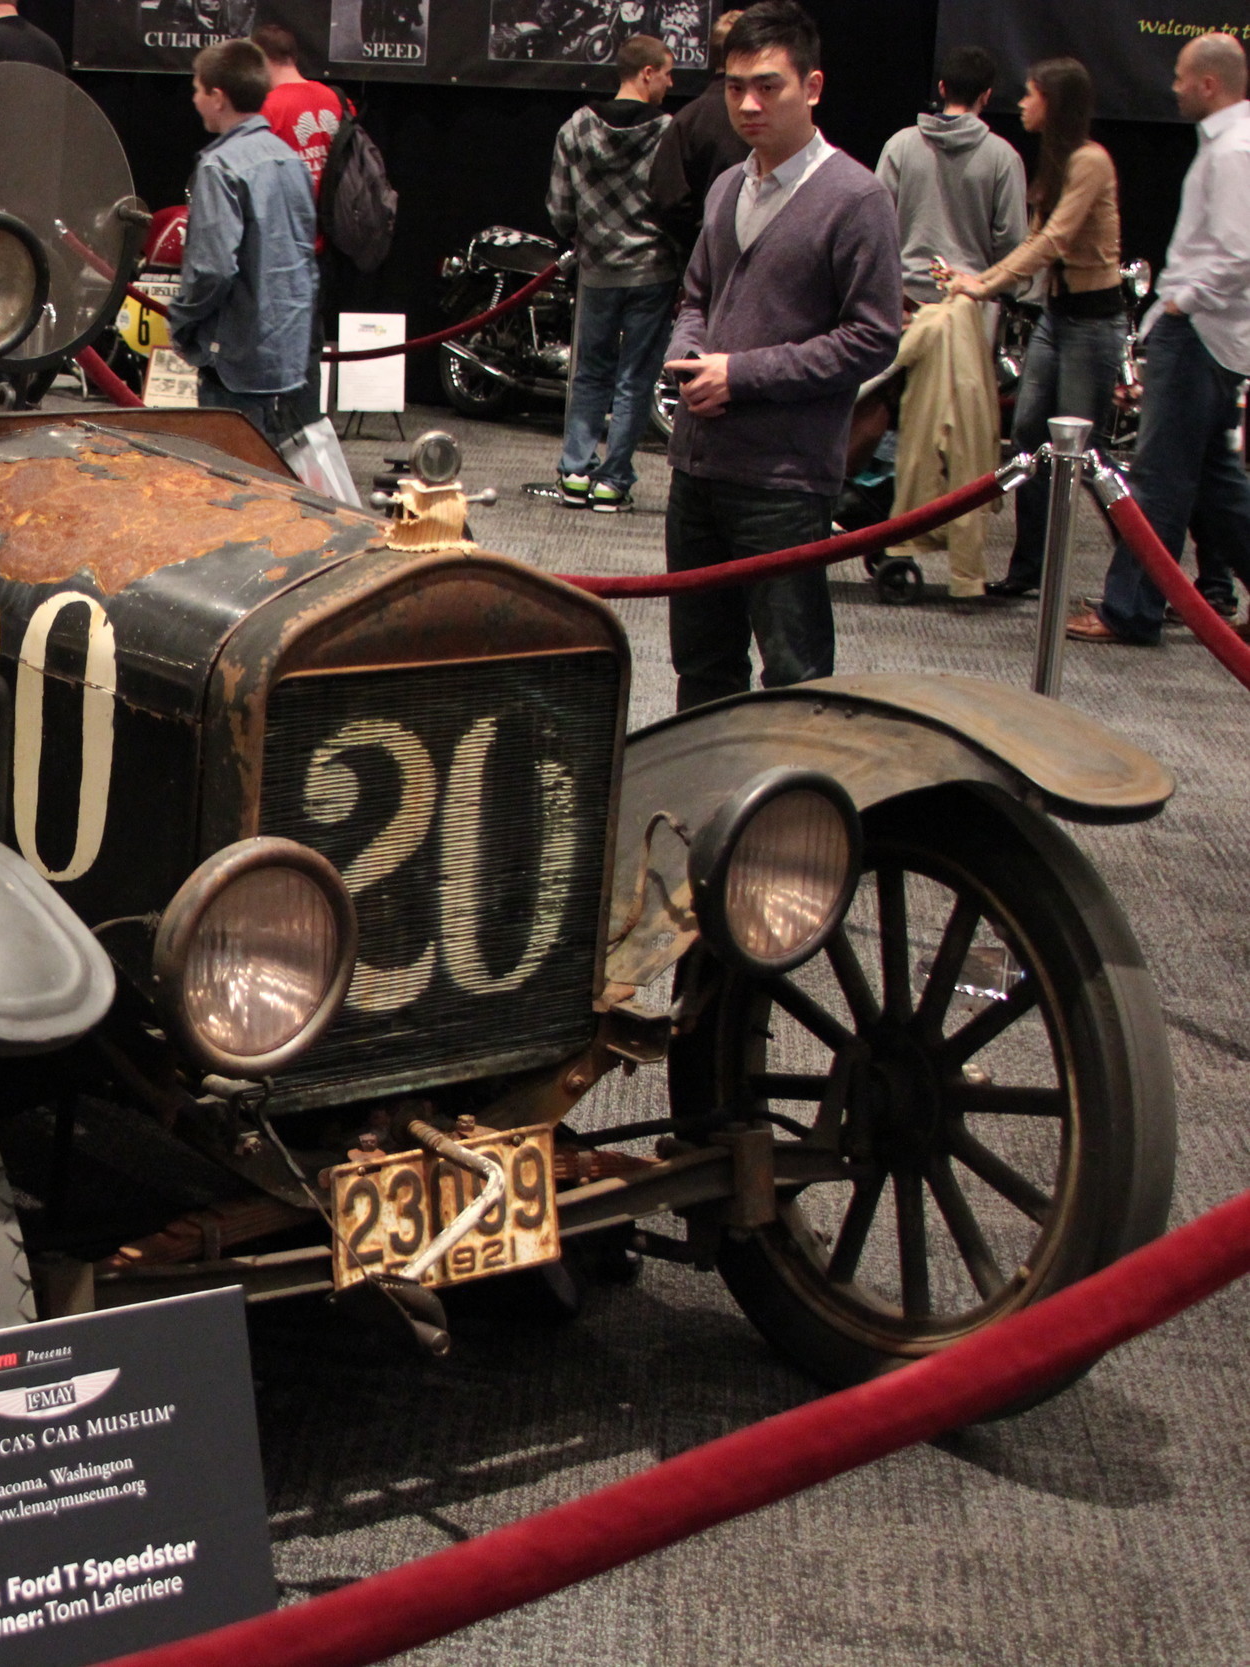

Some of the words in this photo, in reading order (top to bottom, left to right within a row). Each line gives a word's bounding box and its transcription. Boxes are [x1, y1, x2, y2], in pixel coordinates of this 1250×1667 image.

[1138, 19, 1216, 37] Welcome
[362, 42, 422, 59] SPEED
[137, 303, 150, 346] 6
[303, 715, 576, 1013] 20
[26, 1346, 72, 1363] Presents
[41, 1424, 81, 1447] CAR
[50, 1458, 134, 1486] Washington
[7, 1566, 62, 1604] Ford
[63, 1562, 79, 1588] T
[83, 1540, 197, 1586] Speedster
[45, 1598, 90, 1624] Tom
[93, 1575, 184, 1612] Laferriere
